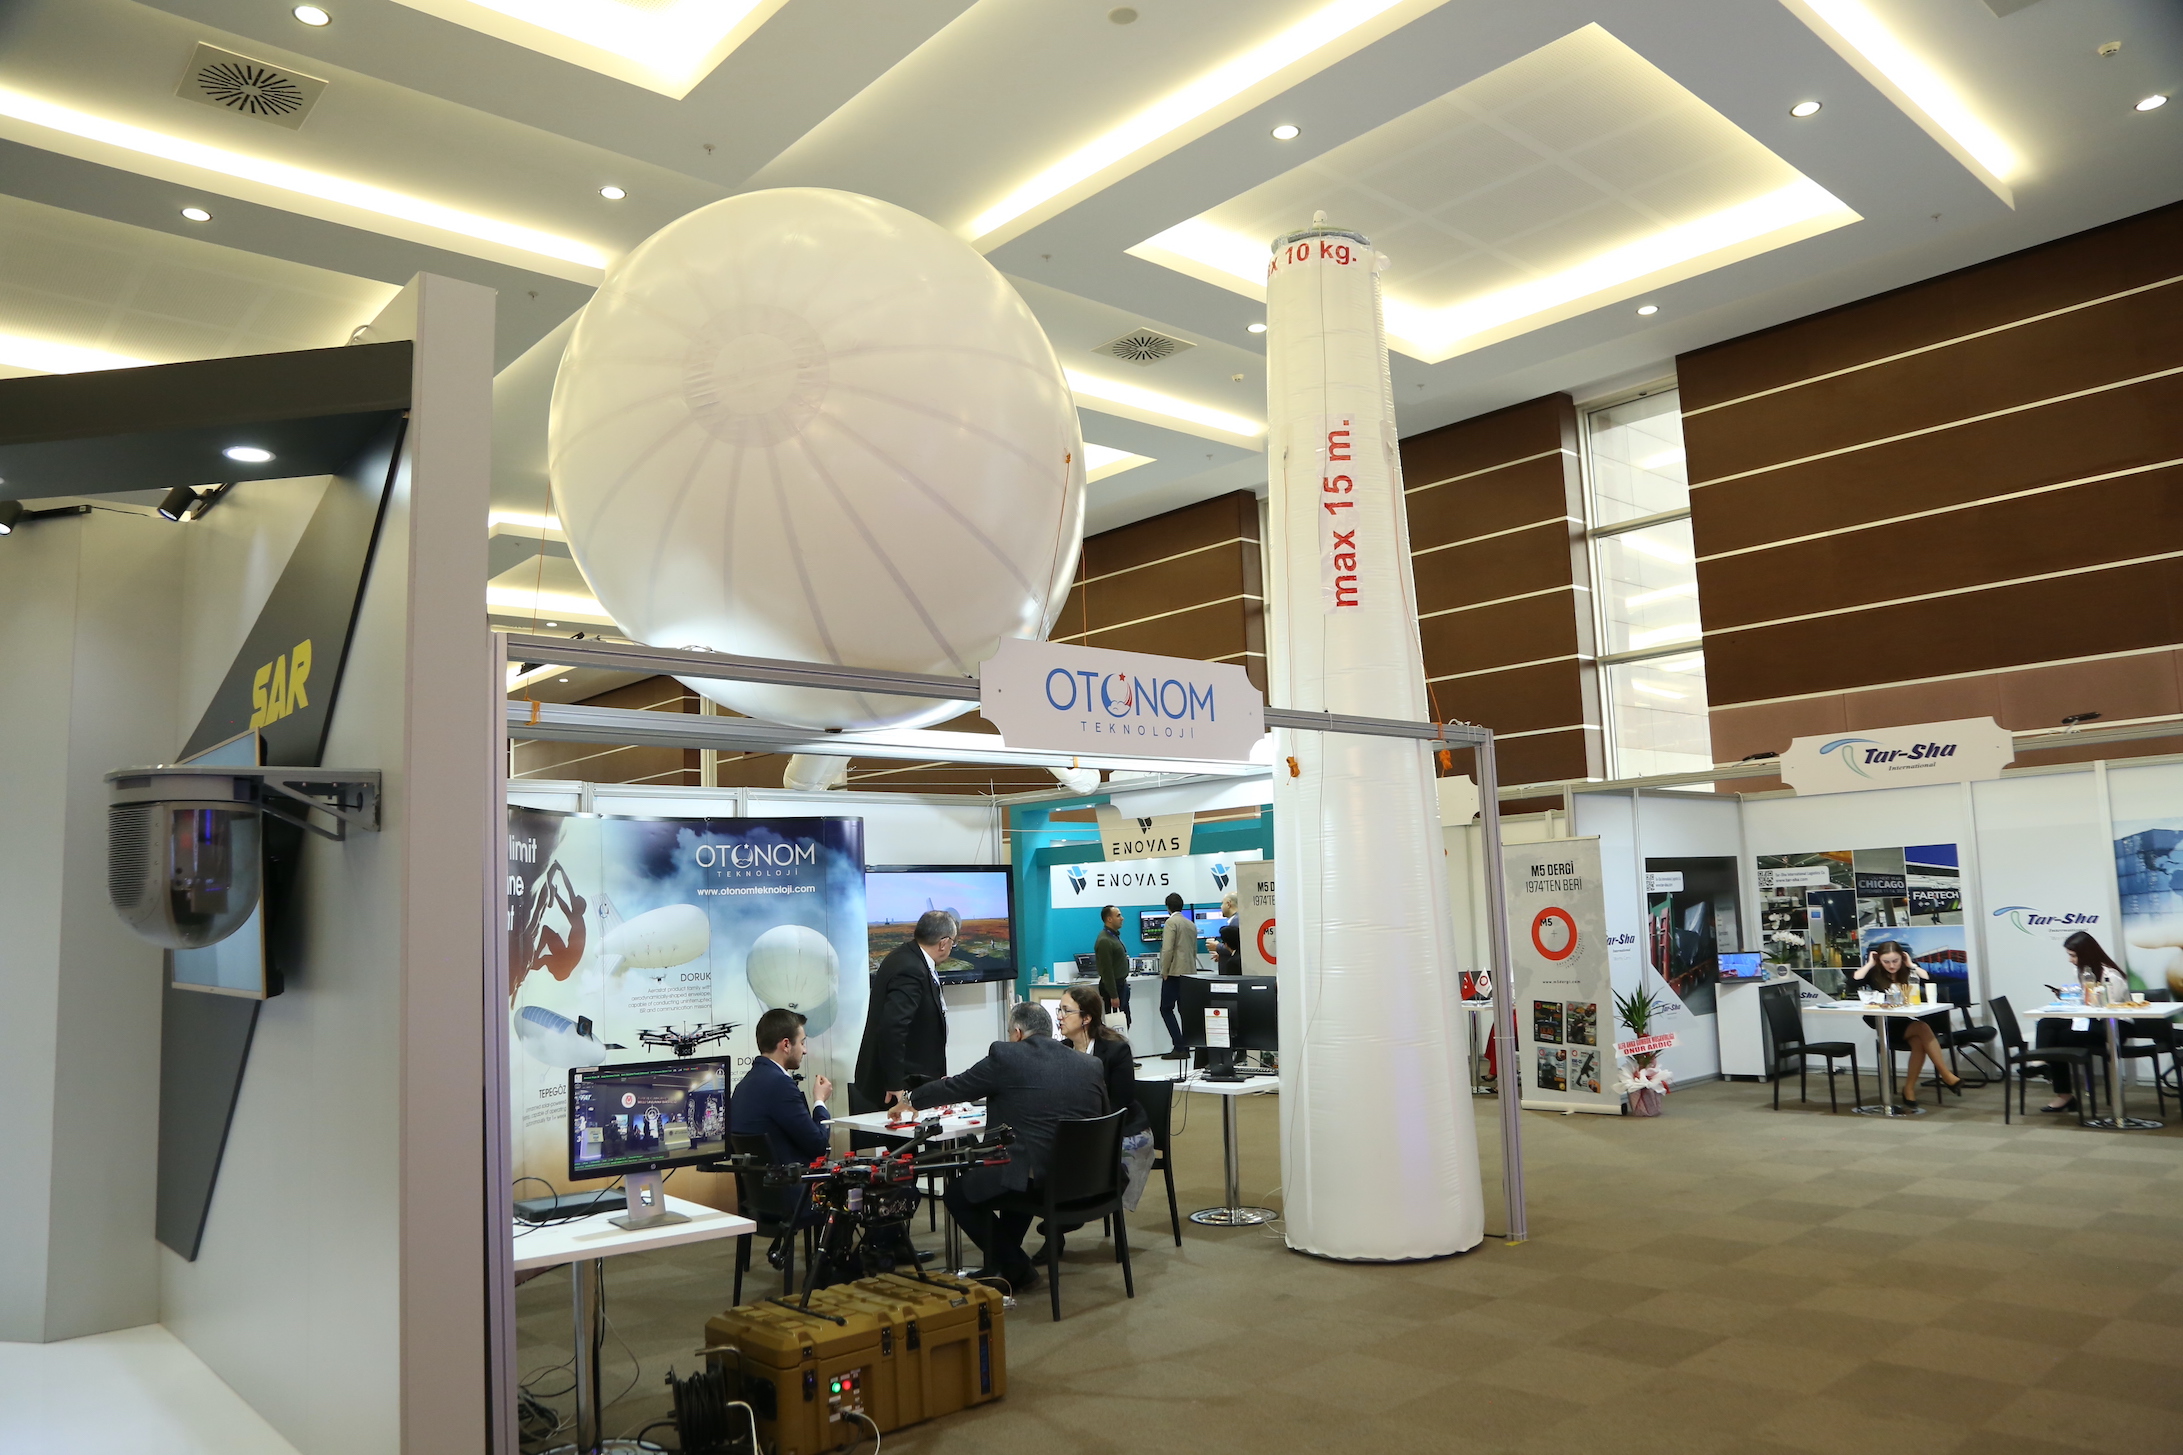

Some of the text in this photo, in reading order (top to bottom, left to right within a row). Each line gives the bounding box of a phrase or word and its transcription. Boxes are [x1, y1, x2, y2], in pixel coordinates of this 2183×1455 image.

[1285, 242, 1310, 265] 10
[1320, 240, 1357, 265] kg.
[1323, 419, 1358, 607] max 15 m.
[249, 638, 312, 729] SAR
[1045, 667, 1215, 722] OTONOM
[1864, 742, 1958, 764] Tar-Sha
[1888, 761, 1937, 771] International
[508, 834, 538, 863] limit
[1112, 837, 1180, 856] ENOVAS
[695, 842, 816, 869] OTONOM
[1531, 860, 1574, 877] M5 DERGİ
[1097, 873, 1170, 887] ENOVAS
[1257, 881, 1269, 893] M5
[1525, 876, 1582, 893] 1974'TEN BERİ
[1858, 879, 1905, 889] CHICAGO
[697, 884, 816, 896] www.otonomteknoloji.com
[1912, 891, 1960, 901] FABTECH
[1539, 918, 1553, 926] M5
[2027, 912, 2100, 926] Tar-Sha
[1606, 933, 1635, 946] ar-Sha
[680, 971, 711, 982] DORUK
[1624, 1046, 1646, 1055] ONUR
[539, 1084, 566, 1098] TEPEGÖZ
